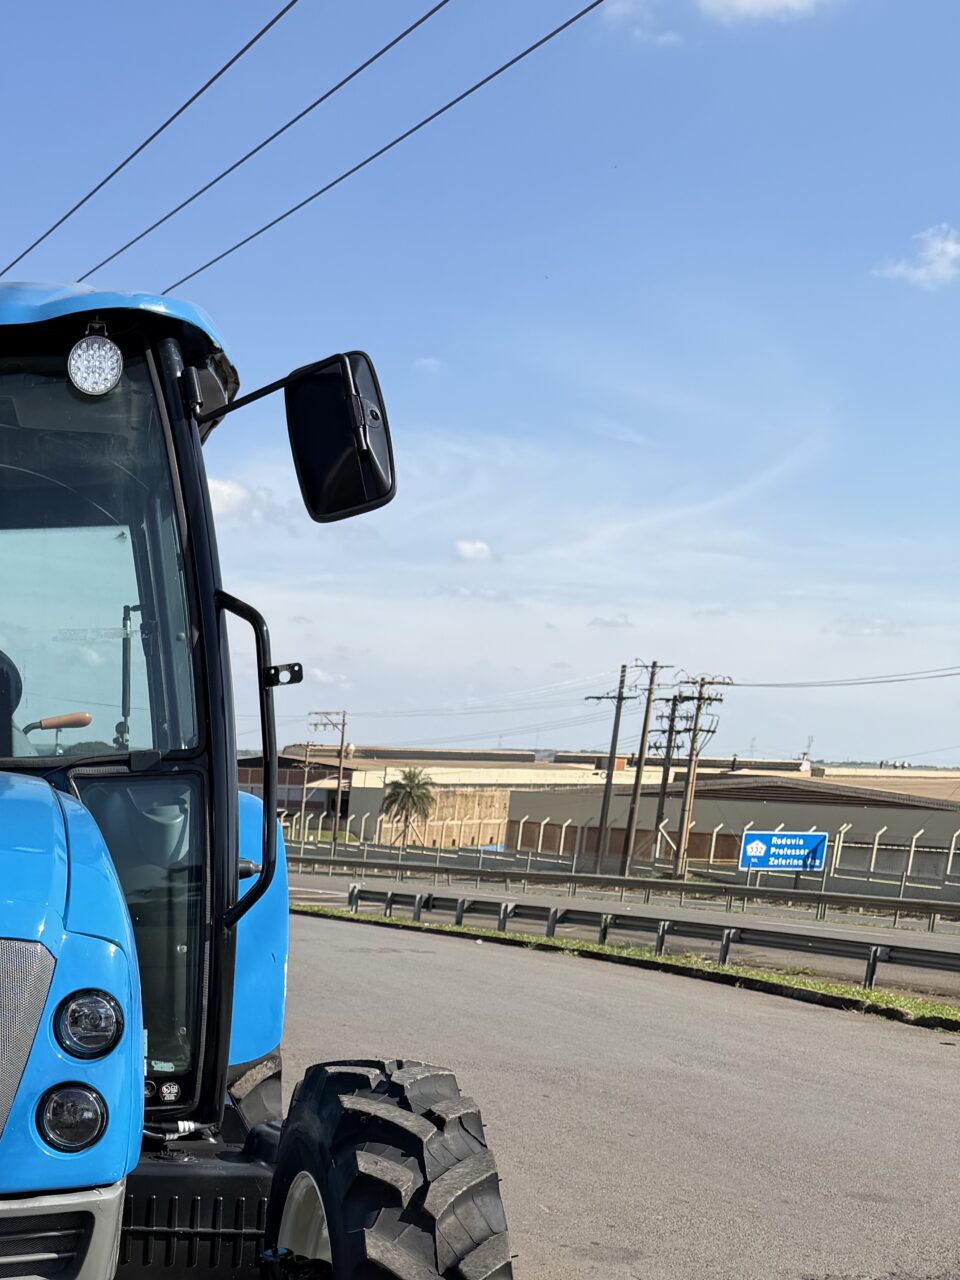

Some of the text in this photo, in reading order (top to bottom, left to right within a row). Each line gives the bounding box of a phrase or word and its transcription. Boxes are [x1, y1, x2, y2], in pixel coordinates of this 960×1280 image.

[771, 836, 804, 845] Rodovia
[770, 847, 809, 855] Professor
[768, 857, 803, 865] Zeferino
